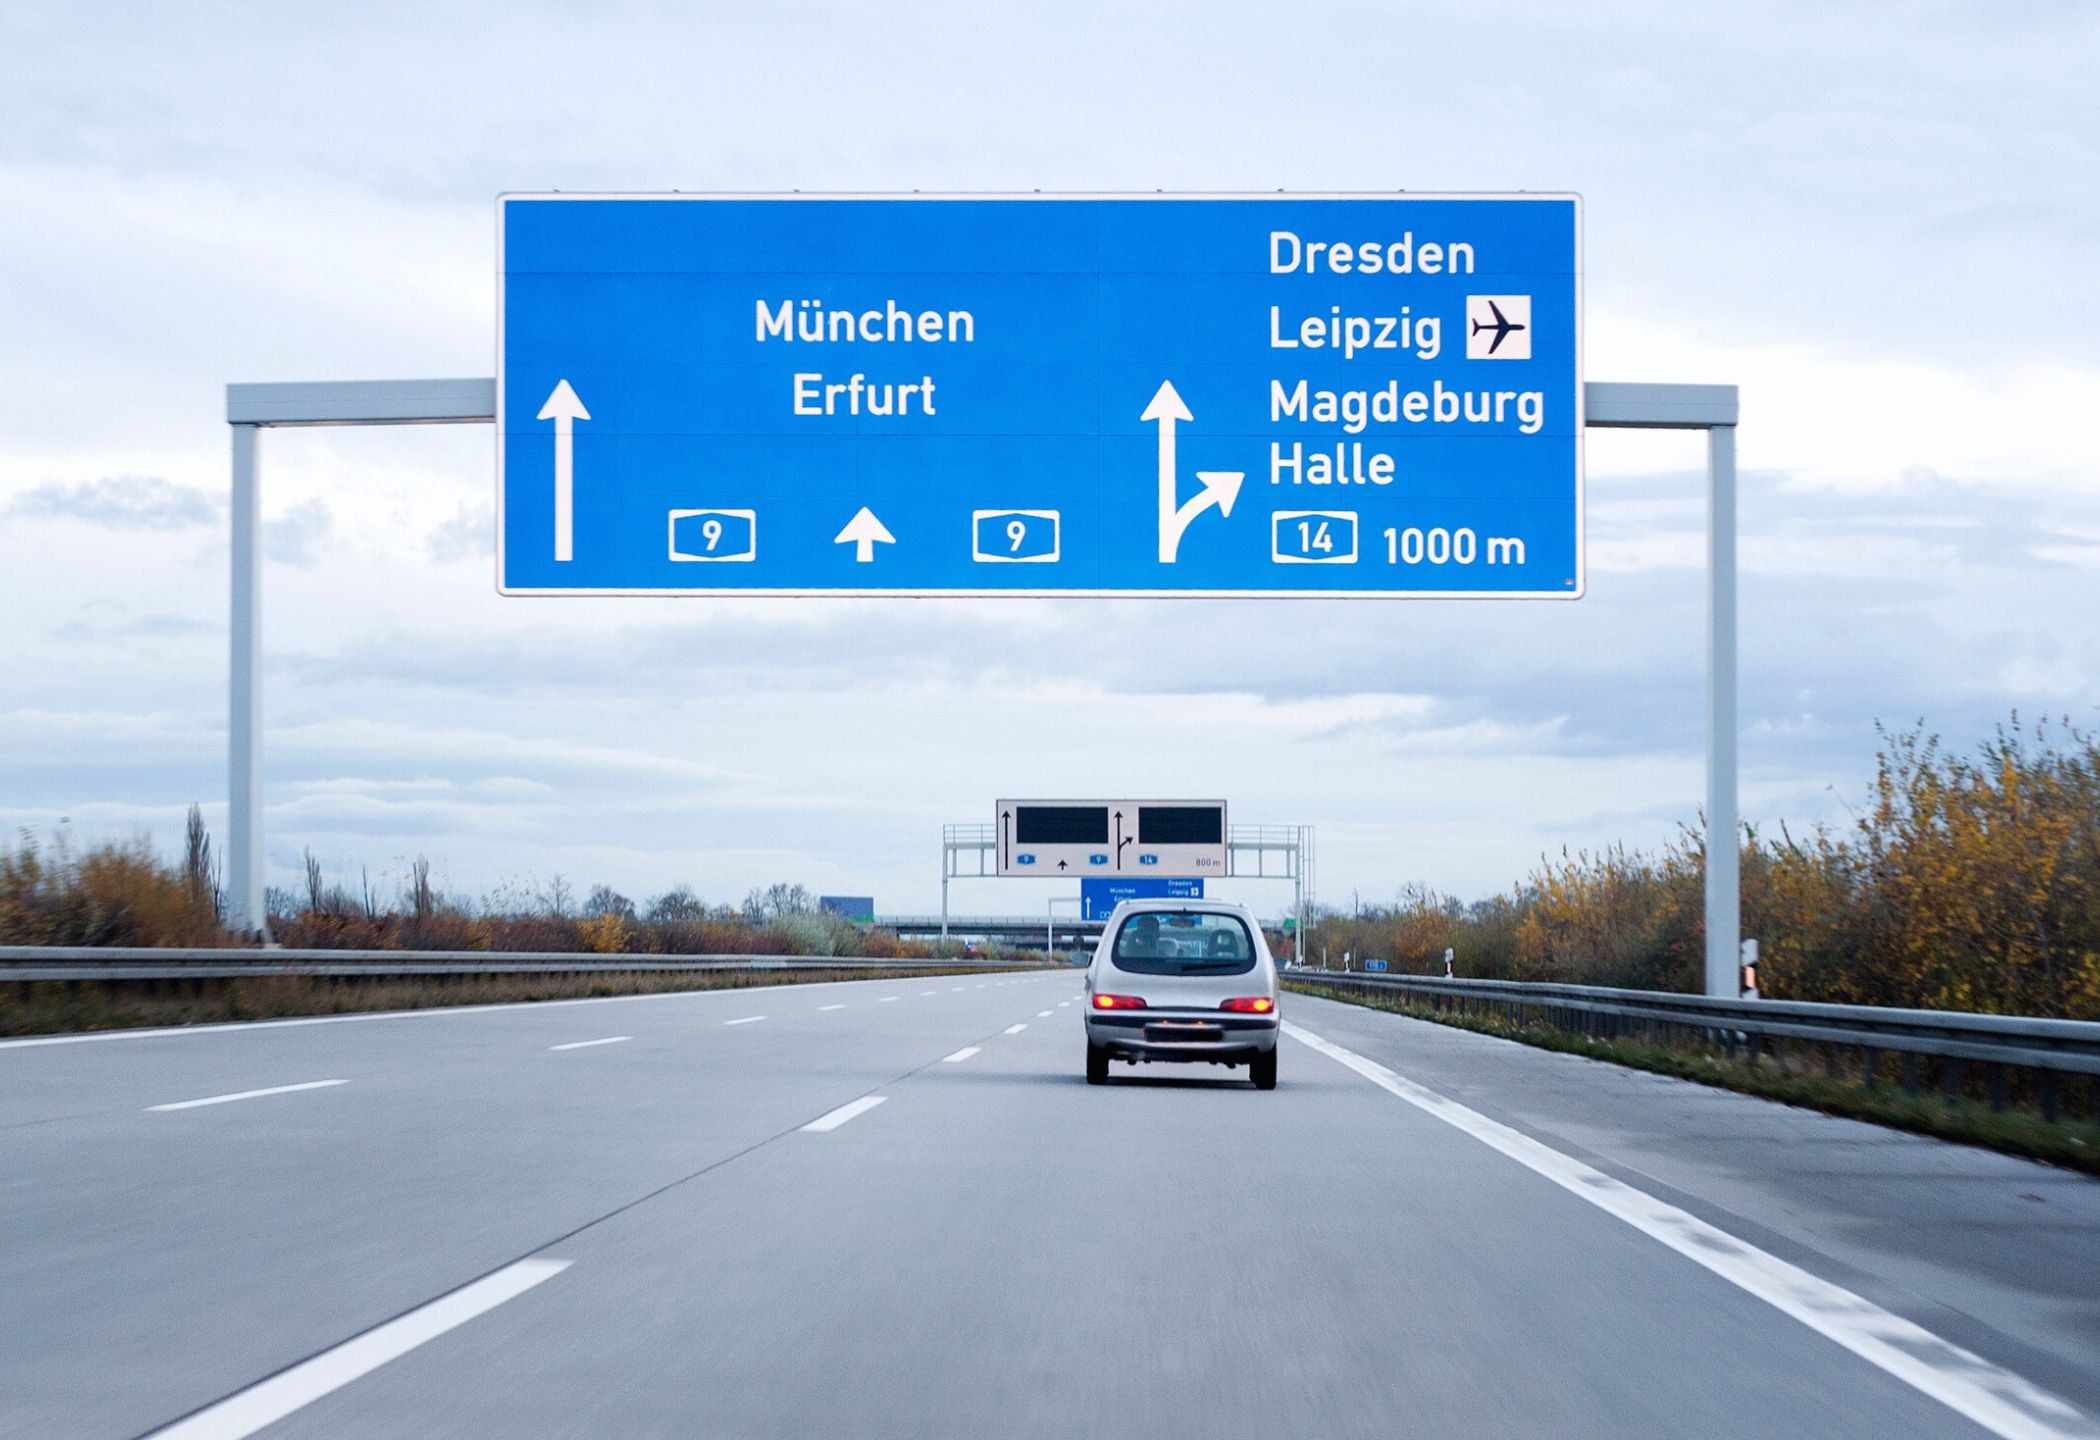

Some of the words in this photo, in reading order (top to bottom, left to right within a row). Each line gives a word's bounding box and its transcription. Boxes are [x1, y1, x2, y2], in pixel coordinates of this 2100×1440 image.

[1270, 232, 1474, 274] Dresden
[756, 299, 974, 342] München
[1270, 306, 1441, 359] Leipzig
[793, 374, 936, 416] Erfurt
[1270, 379, 1544, 434] Magdeburg
[1270, 443, 1395, 485] Halle
[702, 520, 722, 551] 9
[1006, 520, 1026, 552] 9
[1298, 522, 1333, 553] 14
[1383, 528, 1477, 565] 1000
[1487, 537, 1525, 565] m
[1144, 855, 1153, 864] 14
[1195, 857, 1211, 867] 800
